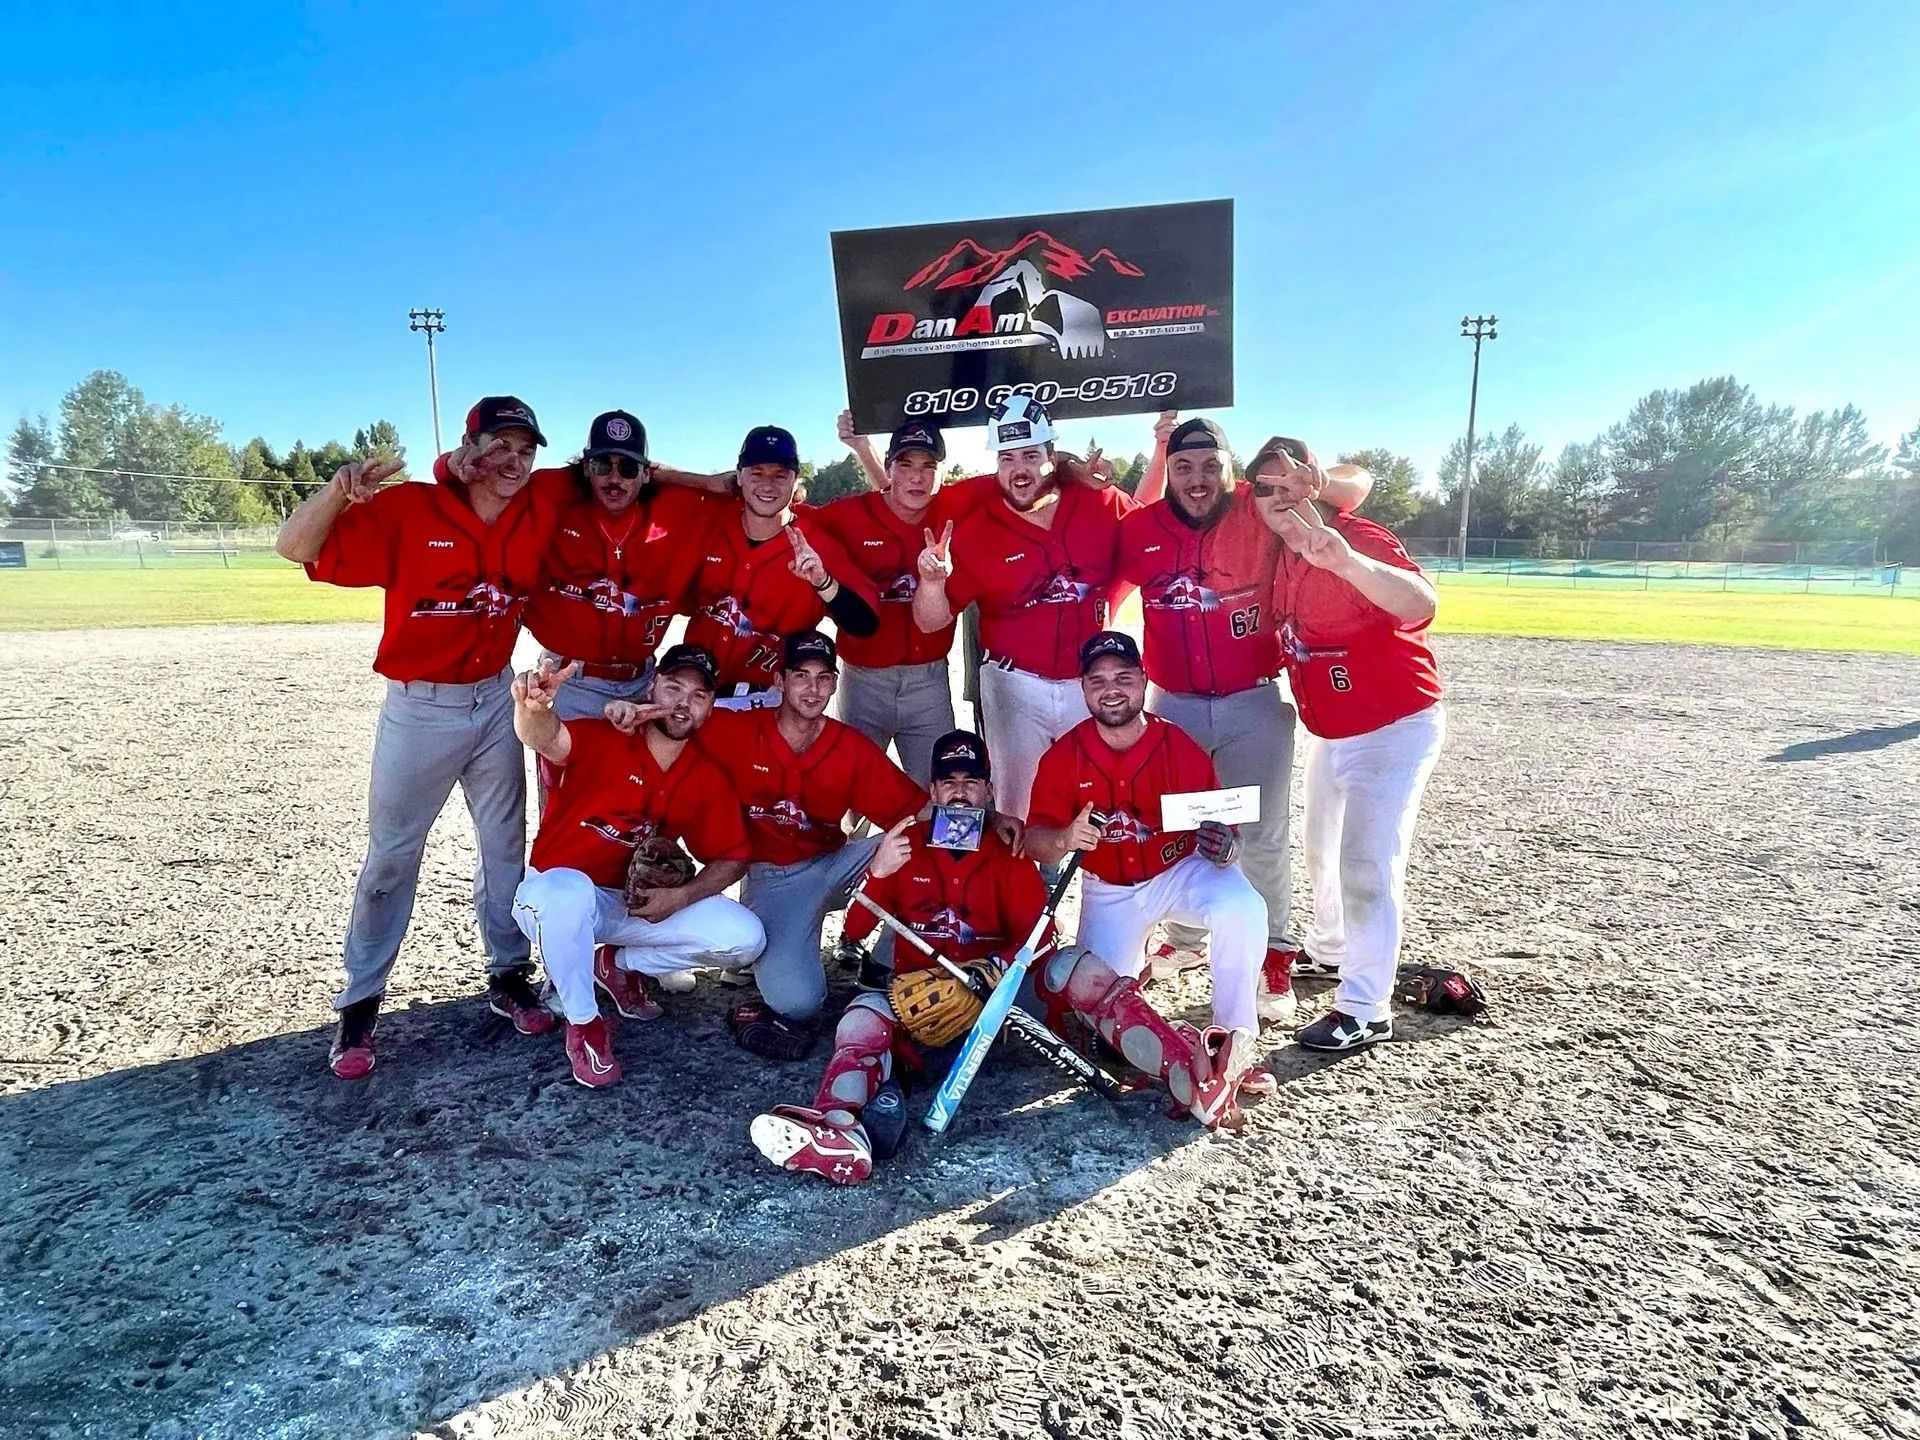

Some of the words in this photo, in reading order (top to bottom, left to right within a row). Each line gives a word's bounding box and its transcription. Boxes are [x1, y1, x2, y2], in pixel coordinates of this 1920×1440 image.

[867, 305, 1025, 344] DanAm
[1106, 304, 1205, 324] EXCAVATION
[904, 387, 979, 416] 819
[1229, 603, 1260, 639] 67
[1329, 665, 1352, 692] 6
[1160, 831, 1190, 865] 26
[951, 1034, 994, 1100] INERTIA
